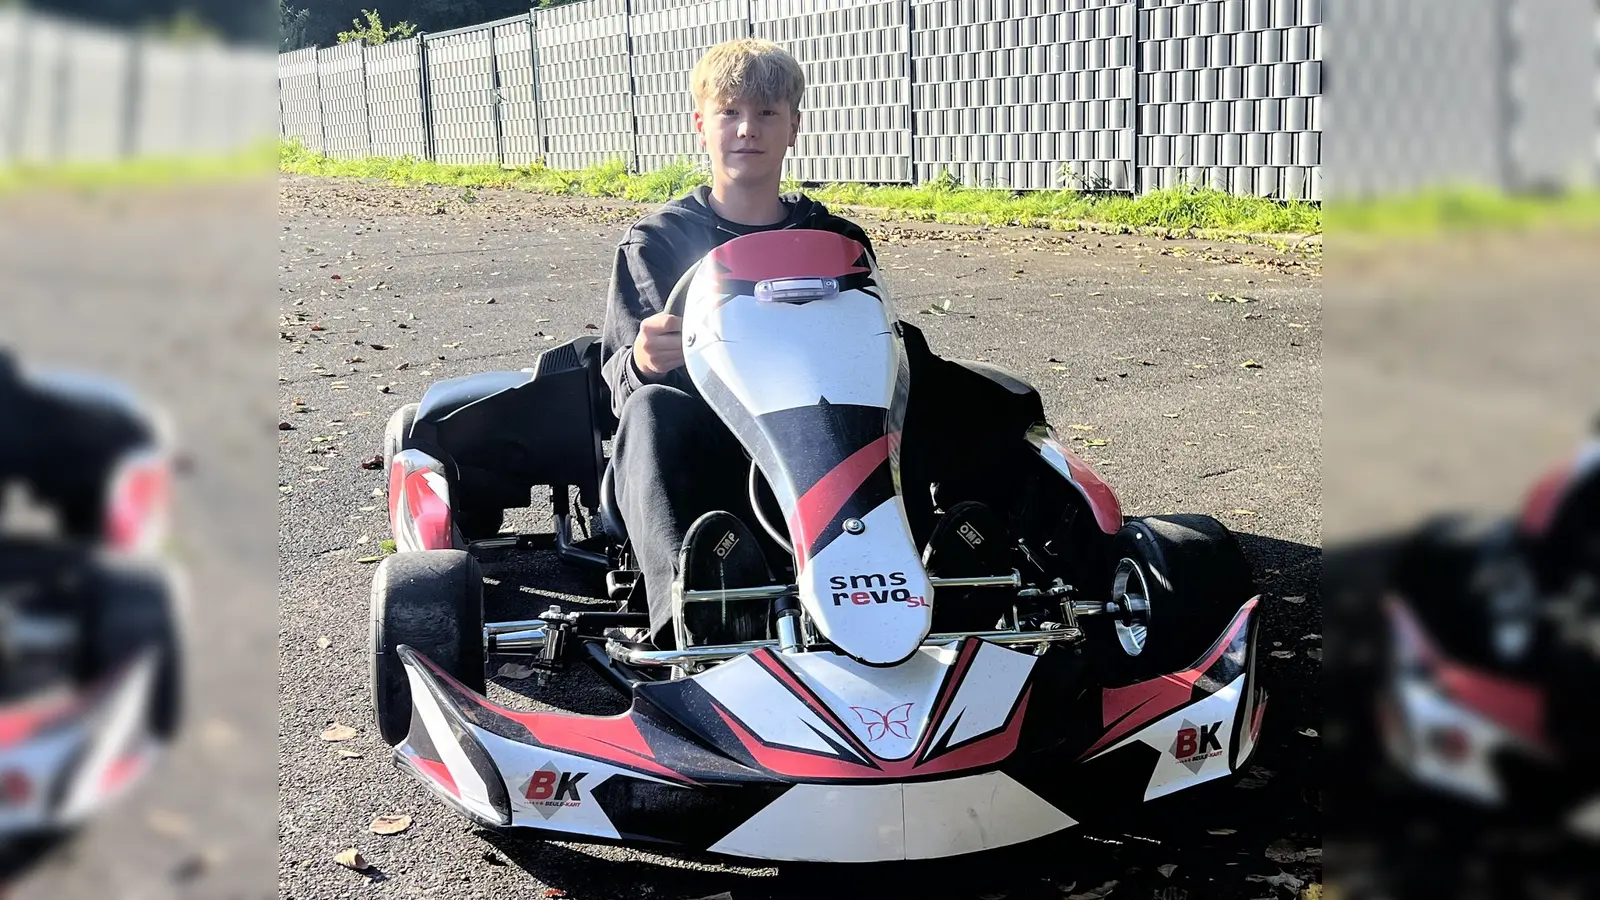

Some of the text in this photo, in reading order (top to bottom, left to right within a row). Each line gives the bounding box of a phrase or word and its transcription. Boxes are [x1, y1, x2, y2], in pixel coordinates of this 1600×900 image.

[716, 533, 735, 557] OMP
[960, 525, 982, 545] OMP
[829, 572, 907, 590] sms
[1175, 720, 1224, 759] BK
[525, 771, 589, 801] BK
